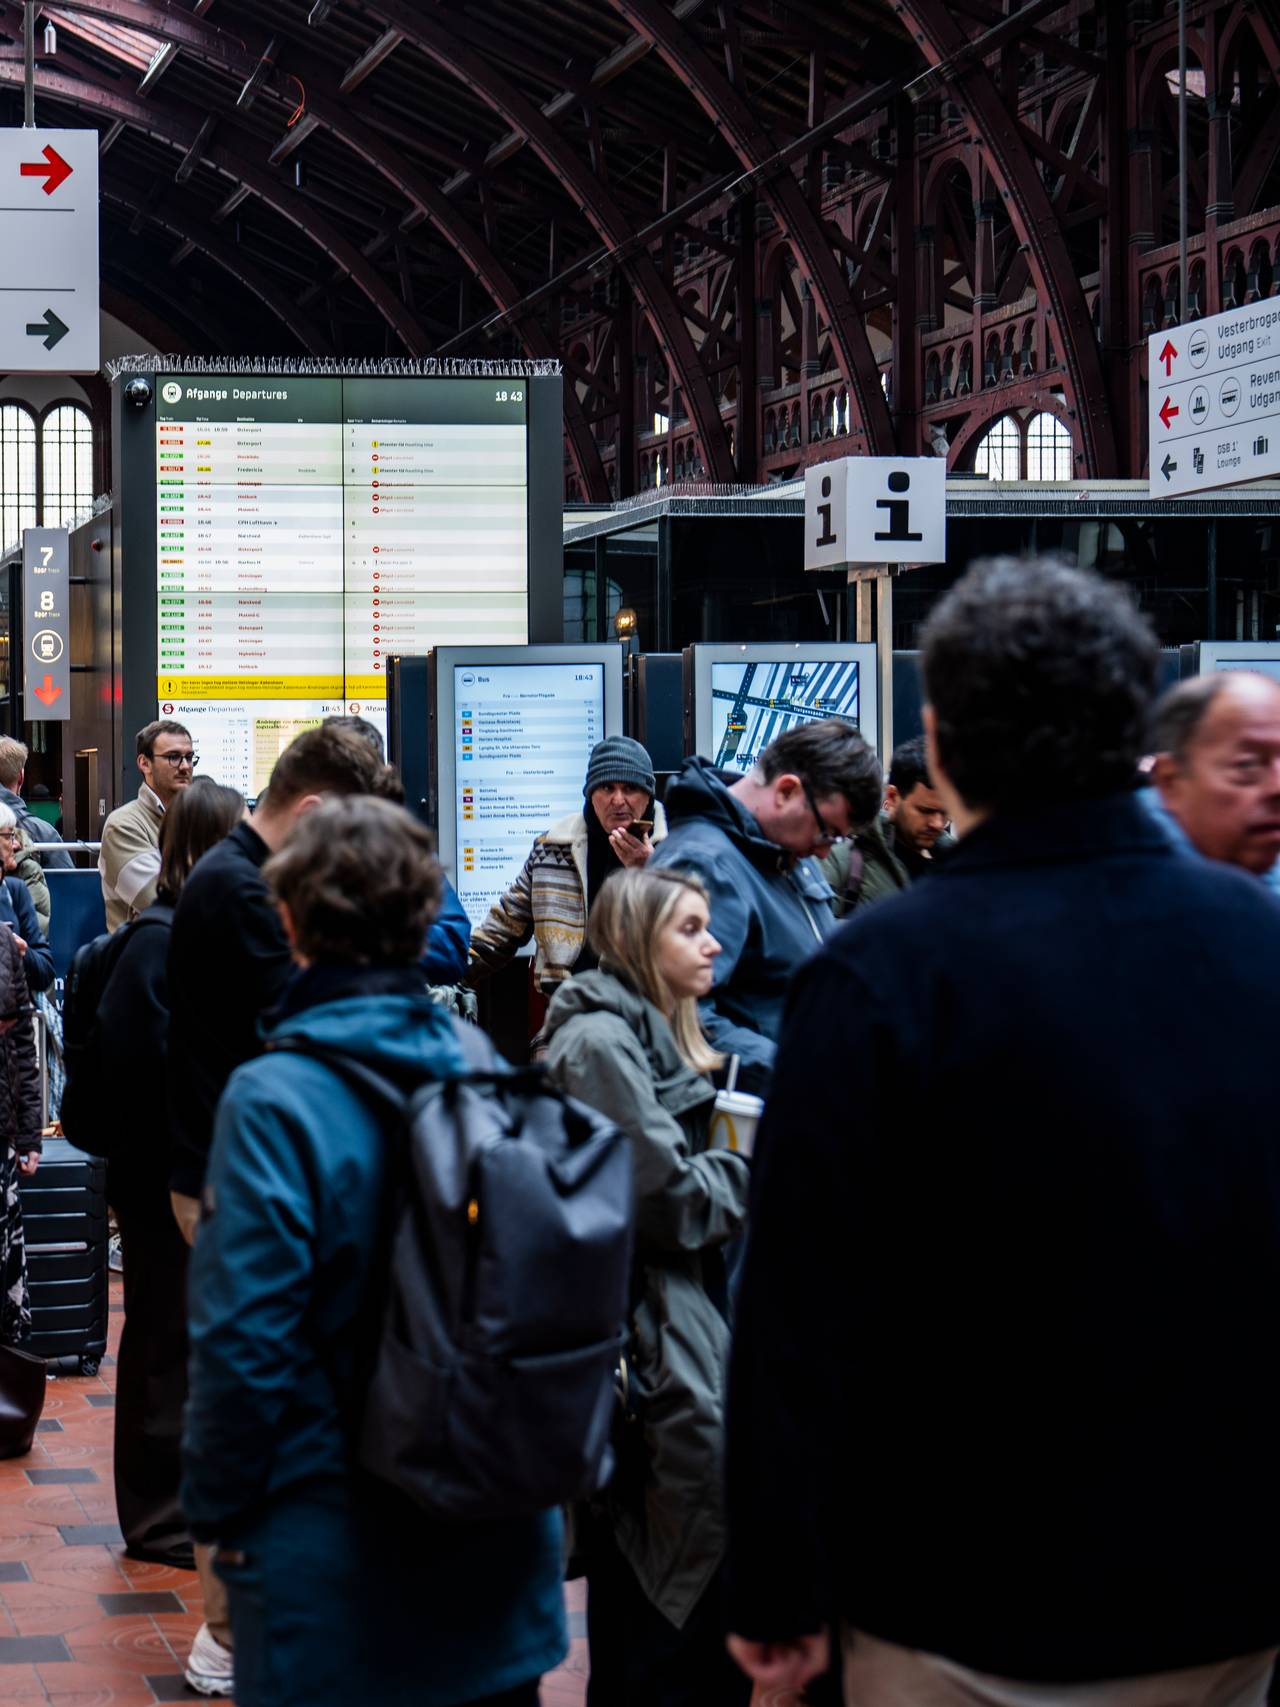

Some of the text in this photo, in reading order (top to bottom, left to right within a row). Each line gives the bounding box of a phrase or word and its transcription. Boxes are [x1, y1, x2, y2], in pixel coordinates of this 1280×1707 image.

[1218, 340, 1254, 359] Udgang
[186, 388, 288, 402] Afgange Departures
[1217, 444, 1230, 455] DSB
[1217, 454, 1241, 469] Lounge
[40, 547, 54, 567] 7
[40, 591, 54, 611] 8
